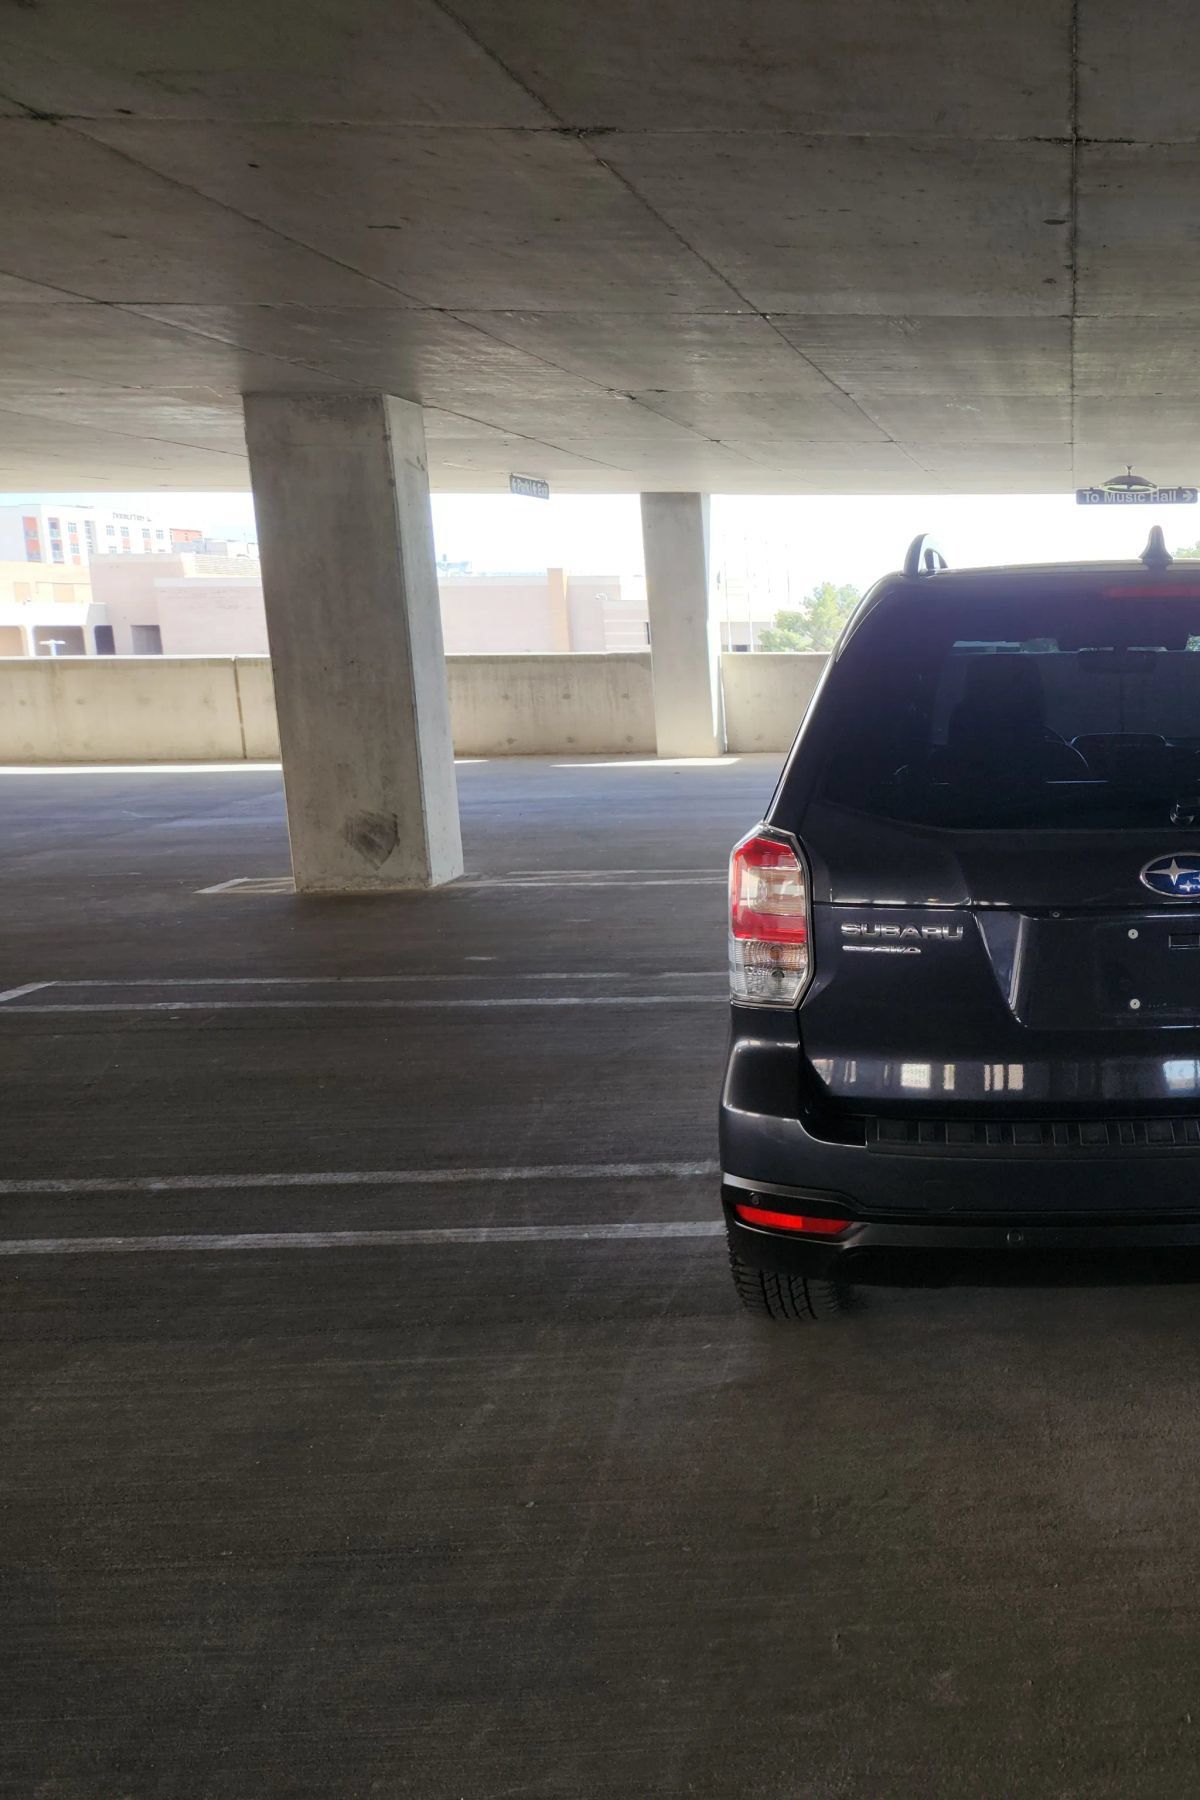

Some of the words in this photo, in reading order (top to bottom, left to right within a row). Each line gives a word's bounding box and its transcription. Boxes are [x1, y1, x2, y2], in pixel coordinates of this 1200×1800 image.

[1083, 490, 1099, 503] To
[1104, 490, 1145, 503] Music
[1150, 490, 1176, 502] Hall
[841, 923, 963, 940] SUBARU
